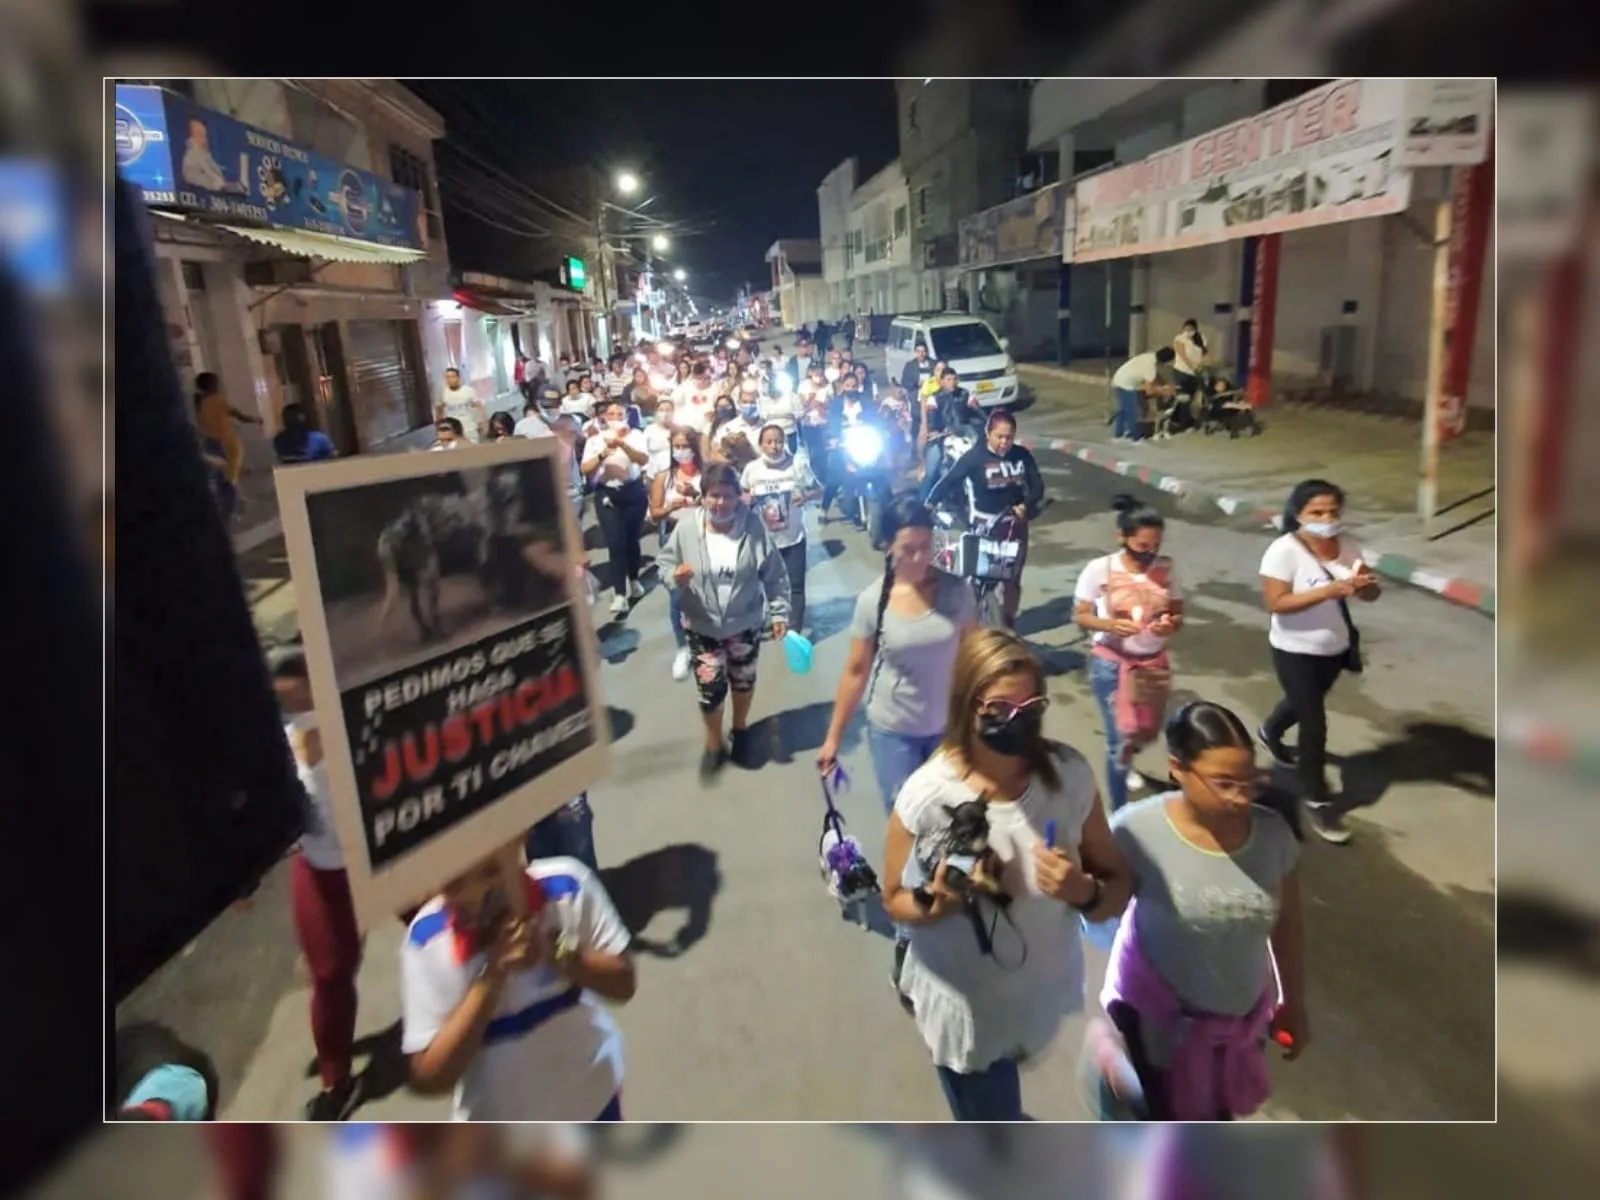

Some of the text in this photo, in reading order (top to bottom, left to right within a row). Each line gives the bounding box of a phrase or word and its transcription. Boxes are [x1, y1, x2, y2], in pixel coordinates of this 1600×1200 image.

[1189, 84, 1358, 177] CENTER
[365, 651, 486, 718] PEDIMOS
[490, 630, 536, 665] QUE
[447, 666, 517, 713] HAGA
[372, 665, 581, 799] JUSTICIA
[373, 785, 445, 847] POR
[450, 762, 484, 800] TI
